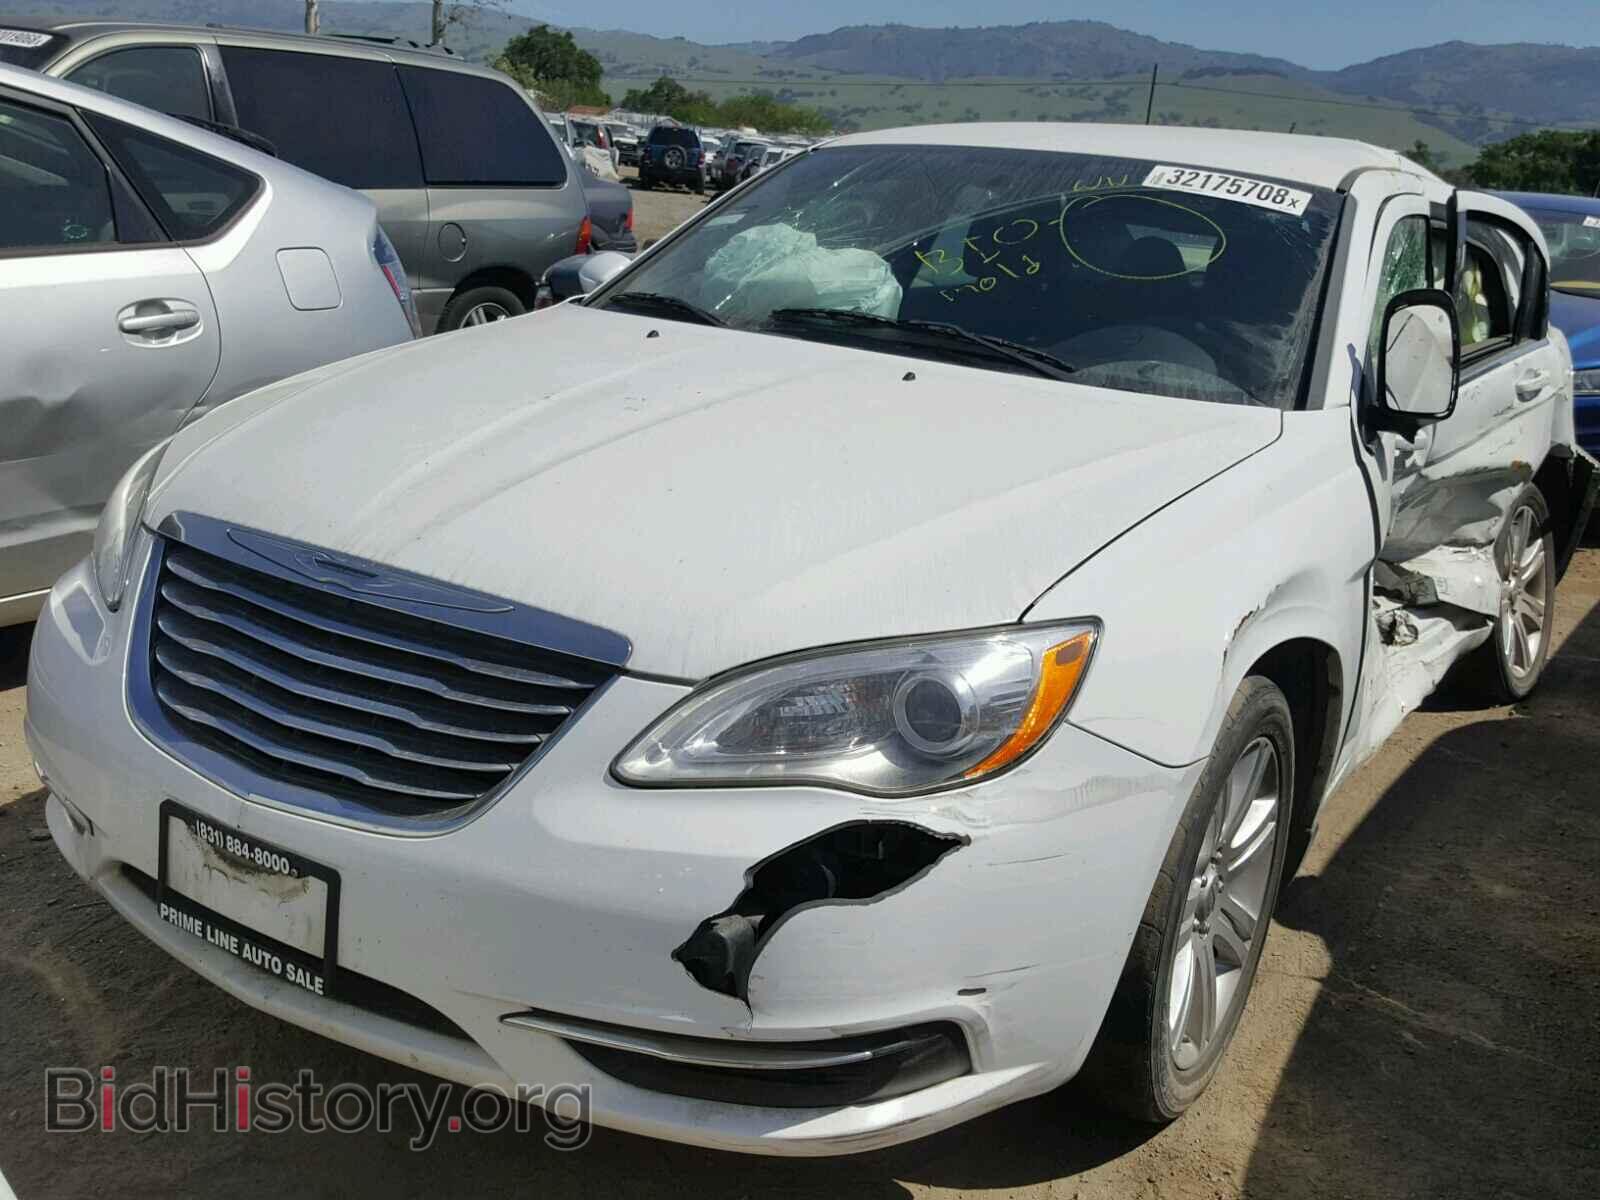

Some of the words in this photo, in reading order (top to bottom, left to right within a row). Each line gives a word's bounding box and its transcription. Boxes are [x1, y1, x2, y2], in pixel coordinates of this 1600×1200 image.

[196, 819, 224, 848] (831)
[159, 902, 203, 937] PRIME
[206, 924, 239, 956] LINE
[242, 942, 282, 975] AUTO
[286, 963, 325, 996] SALE
